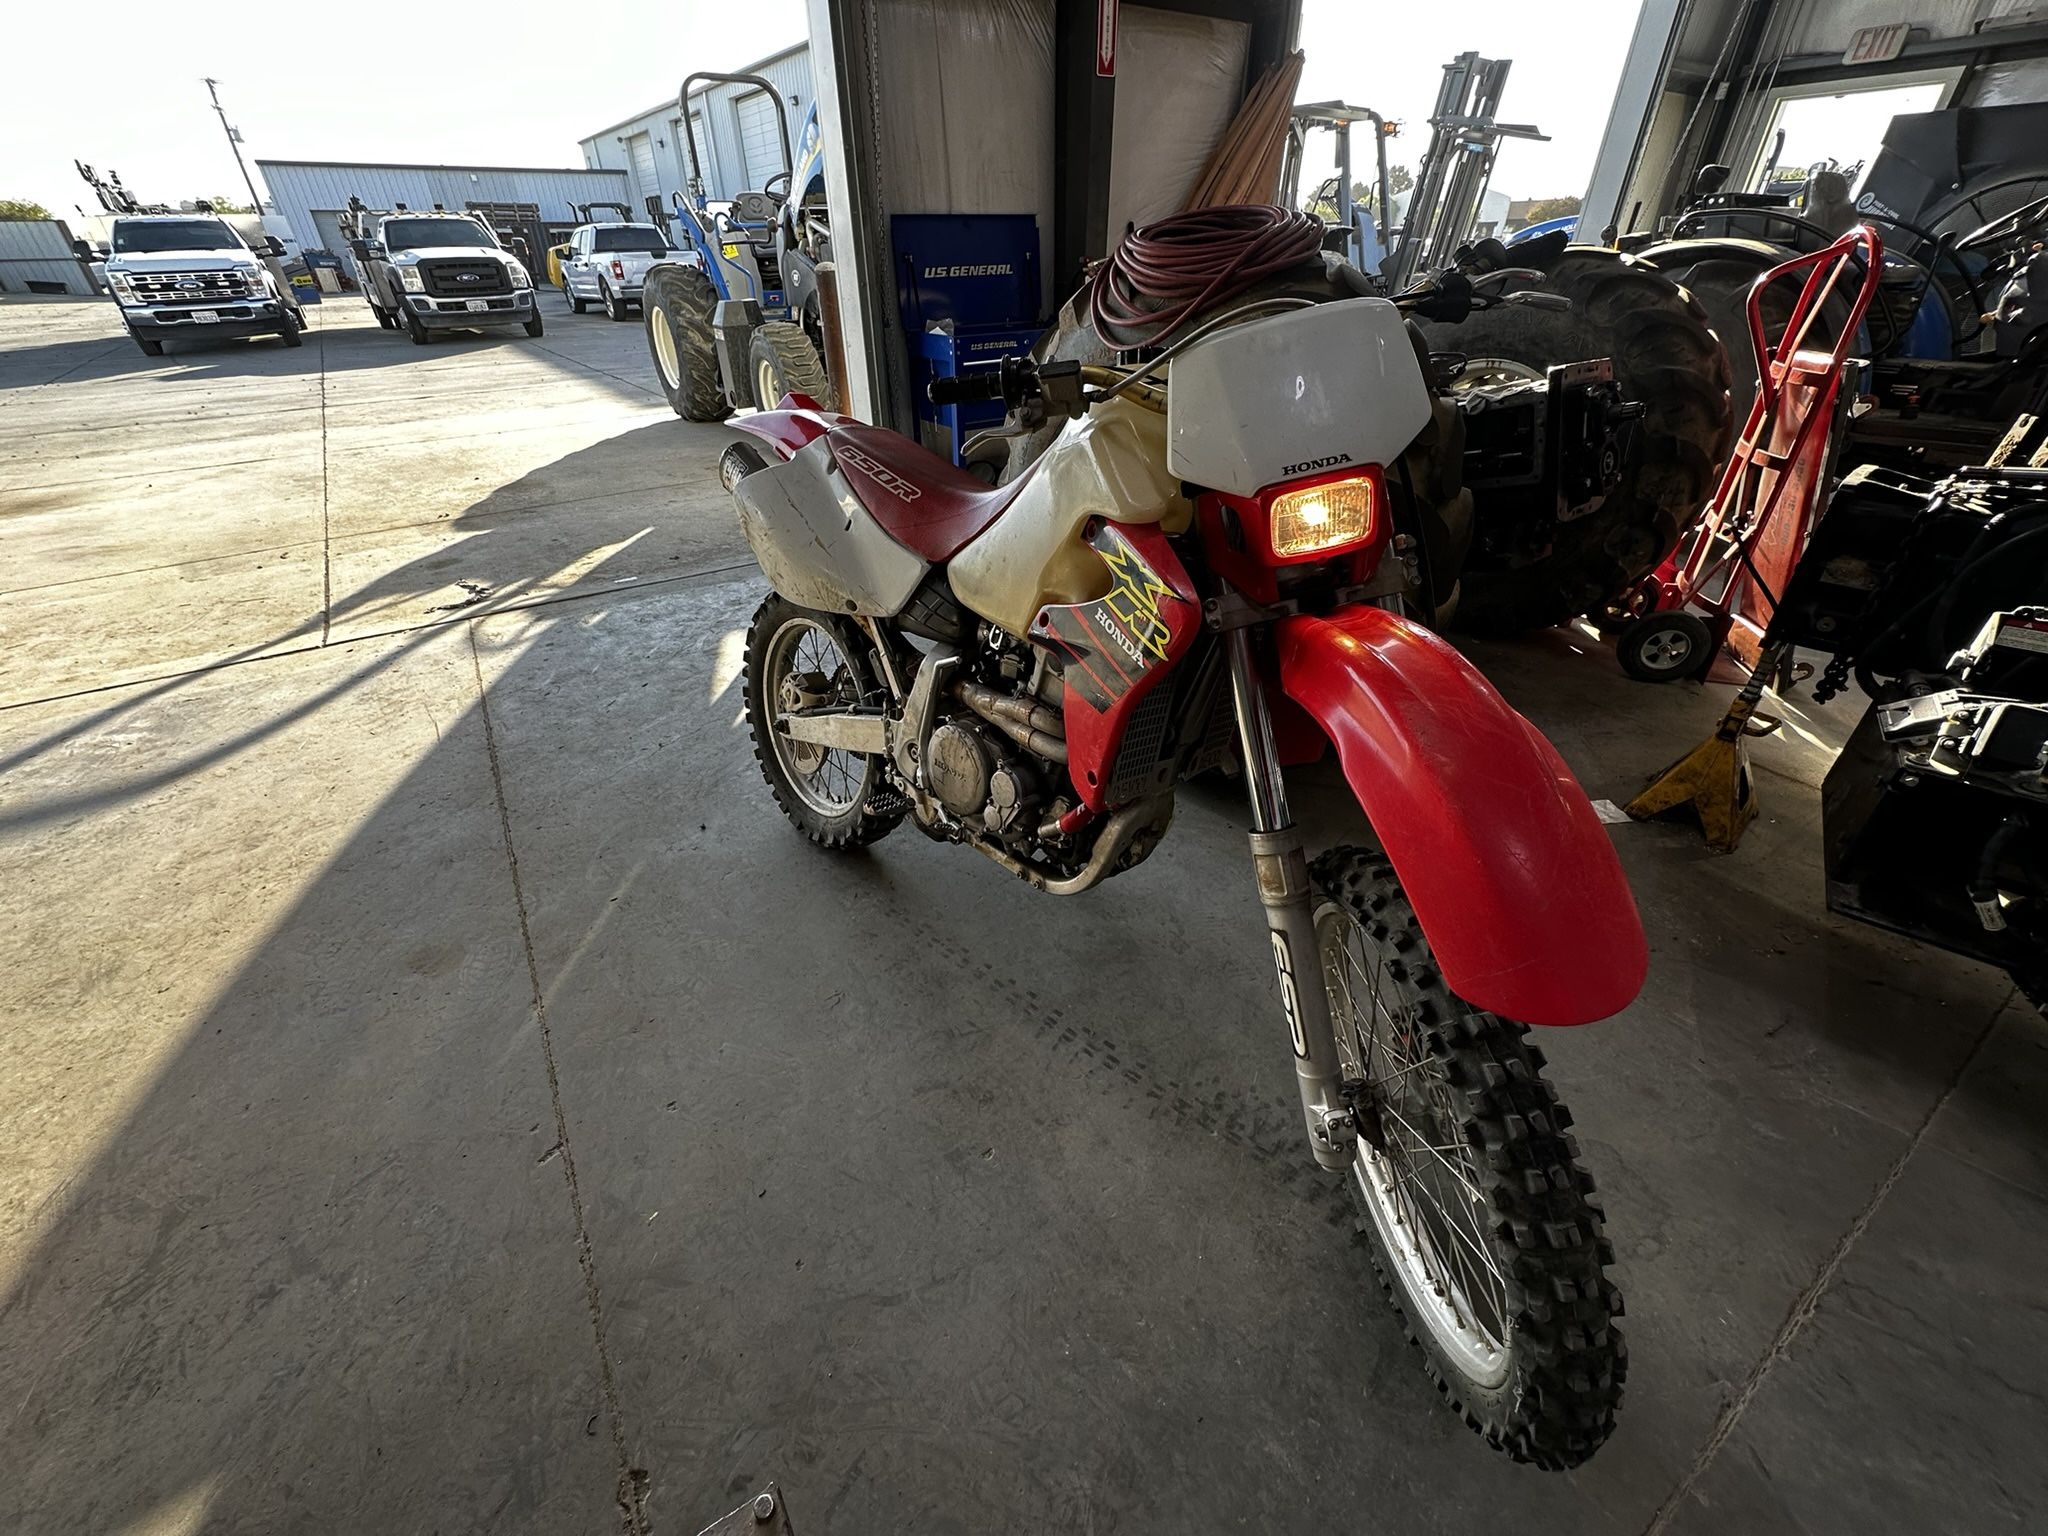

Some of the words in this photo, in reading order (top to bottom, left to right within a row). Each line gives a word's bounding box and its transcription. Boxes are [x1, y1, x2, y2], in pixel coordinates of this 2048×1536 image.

[1851, 25, 1903, 61] EXIT
[949, 264, 1014, 277] GENERAL
[837, 445, 921, 503] 650R
[1282, 453, 1352, 475] HONDA
[1099, 538, 1182, 661] XR
[1094, 608, 1145, 669] HONDA
